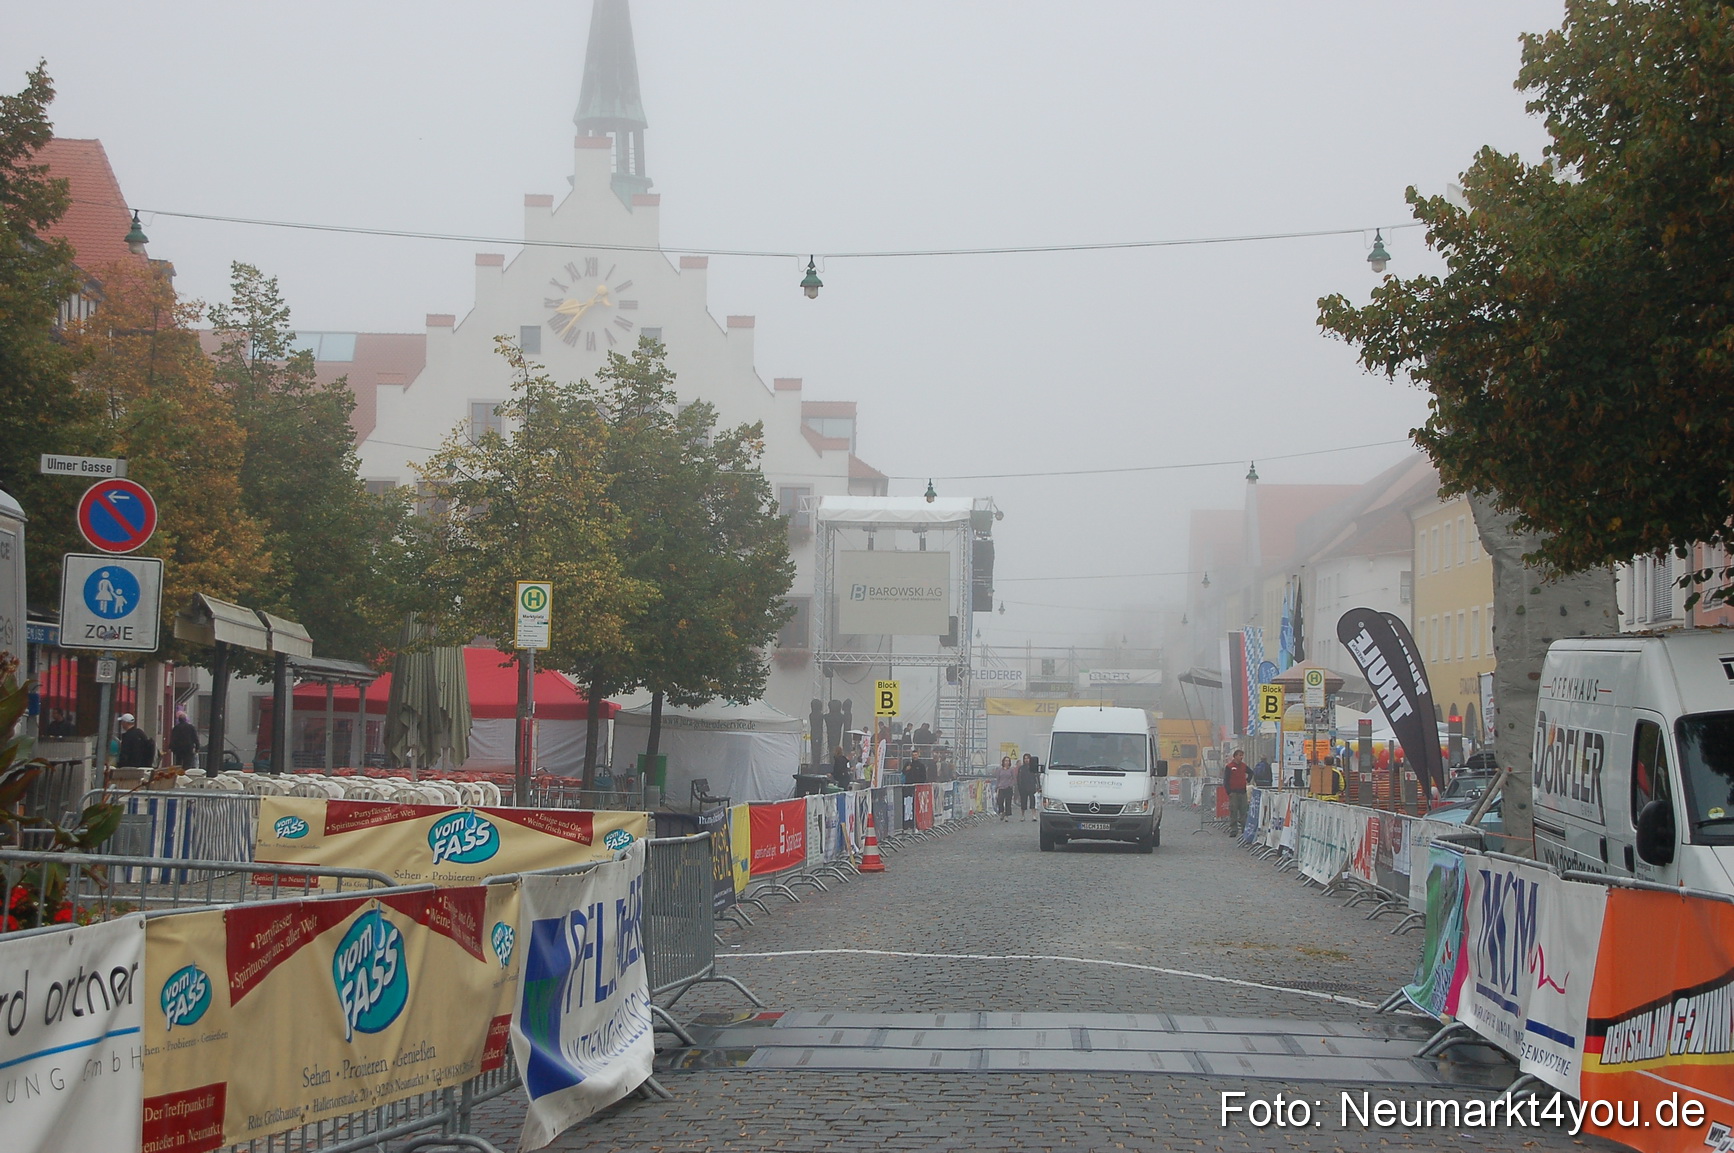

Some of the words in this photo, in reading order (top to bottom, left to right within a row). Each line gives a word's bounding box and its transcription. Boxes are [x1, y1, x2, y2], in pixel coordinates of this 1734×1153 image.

[47, 458, 77, 472] Ulmer
[81, 461, 112, 473] Gasse
[869, 587, 924, 597] BAROWSKI
[926, 587, 943, 597] AG
[85, 624, 134, 641] ZONE
[877, 681, 898, 690] Block
[967, 669, 1023, 681] FLEIDERER
[1347, 628, 1414, 723] THULE
[881, 691, 894, 709] B
[1262, 685, 1283, 693] Block
[1551, 677, 1600, 701] OFENHAUS
[1265, 695, 1279, 714] B
[276, 817, 294, 829] vom
[331, 818, 370, 832] Spirituosen
[370, 816, 383, 824] aus
[383, 812, 400, 822] aller
[399, 809, 417, 818] Welt
[354, 806, 392, 819] Partyfässer
[539, 813, 559, 826] Essige
[559, 818, 571, 829] und
[571, 821, 582, 833] Öle
[275, 819, 305, 839] FASS
[434, 818, 466, 840] vom
[527, 816, 545, 828] Weine
[544, 821, 562, 835] frisch
[562, 828, 577, 838] vom
[577, 832, 591, 844] Fass
[605, 831, 620, 841] vom
[431, 820, 491, 865] FASS
[605, 831, 631, 851] FASS
[253, 874, 280, 884] Genießr
[288, 875, 318, 885] Neumkt
[394, 869, 422, 880] Sehen
[432, 872, 476, 882] Probieren
[430, 908, 451, 929] Weine
[255, 912, 293, 950] Partyfässer
[234, 951, 272, 990] Spirituosen
[272, 942, 285, 957] aus
[285, 929, 301, 948] aller
[300, 914, 318, 936] Welt
[338, 923, 373, 981] vom
[45, 961, 139, 1026] ortner
[165, 971, 190, 1000] vom
[341, 927, 398, 1042] FASS
[166, 971, 206, 1031] FASS
[144, 1044, 160, 1057] hen
[166, 1037, 198, 1052] Probieren
[201, 1030, 229, 1046] Genießen
[303, 1067, 332, 1089] Sehen
[396, 1040, 437, 1068] Genießen
[1520, 1042, 1572, 1078] SENSYSTEME
[144, 1105, 164, 1123] Der
[165, 1096, 206, 1119] Treffpunkt
[205, 1094, 216, 1108] für
[177, 1131, 186, 1146] in
[188, 1122, 221, 1142] Neumarkt
